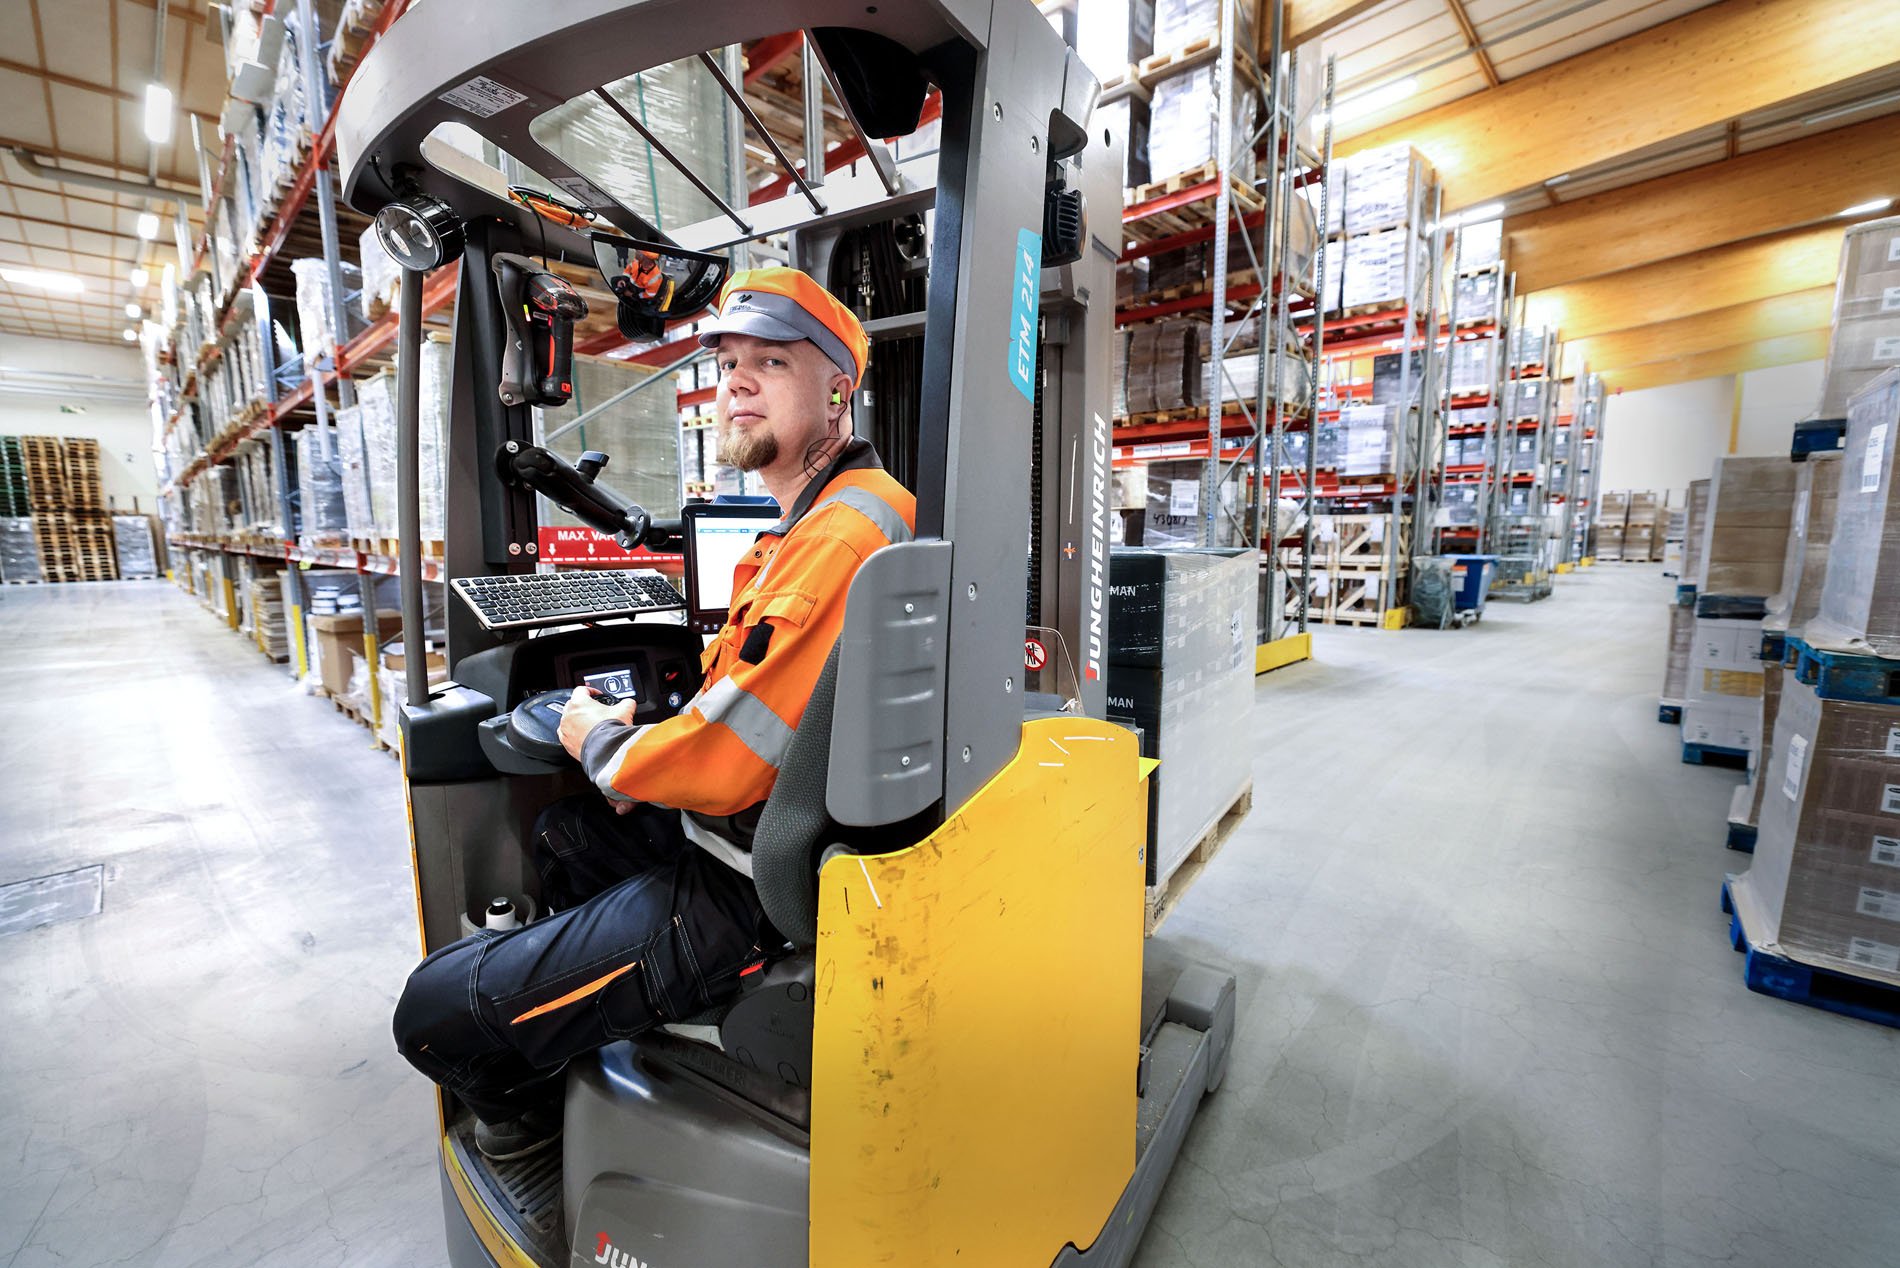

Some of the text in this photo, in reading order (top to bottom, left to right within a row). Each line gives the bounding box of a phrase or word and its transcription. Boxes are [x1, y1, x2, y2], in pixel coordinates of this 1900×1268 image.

[1017, 249, 1035, 384] ETM 214
[557, 530, 589, 541] MAX.
[1085, 411, 1106, 684] JUNGHEINRICH
[1109, 585, 1136, 597] MAN
[1107, 696, 1134, 709] MAN
